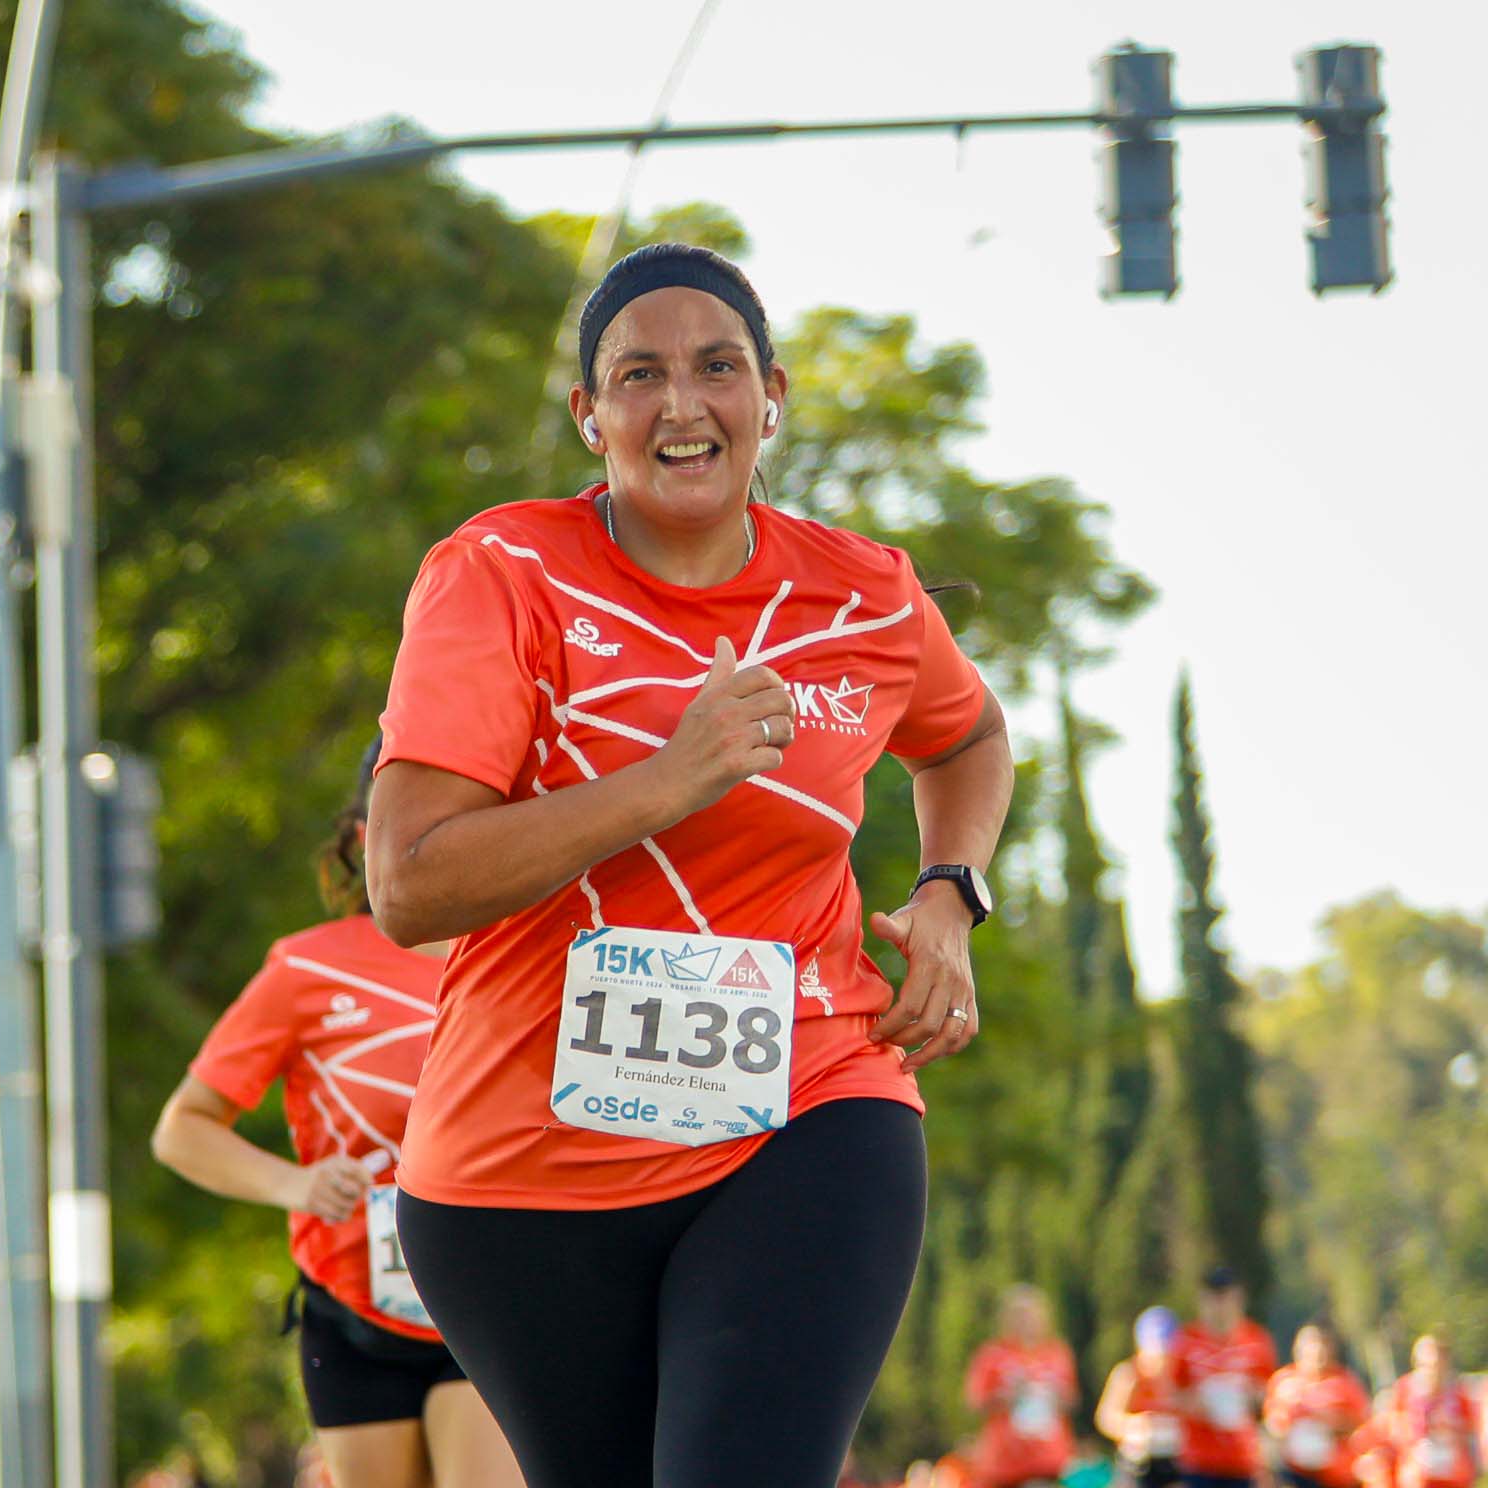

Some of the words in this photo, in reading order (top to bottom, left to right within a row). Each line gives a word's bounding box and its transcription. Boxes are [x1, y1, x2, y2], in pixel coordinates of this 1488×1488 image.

[799, 719, 826, 730] RTO
[593, 943, 655, 976] 15K
[731, 967, 760, 984] 15K
[570, 990, 782, 1074] 1138
[614, 1065, 685, 1087] Fernández
[688, 1075, 727, 1092] Elena
[583, 1095, 659, 1122] osde
